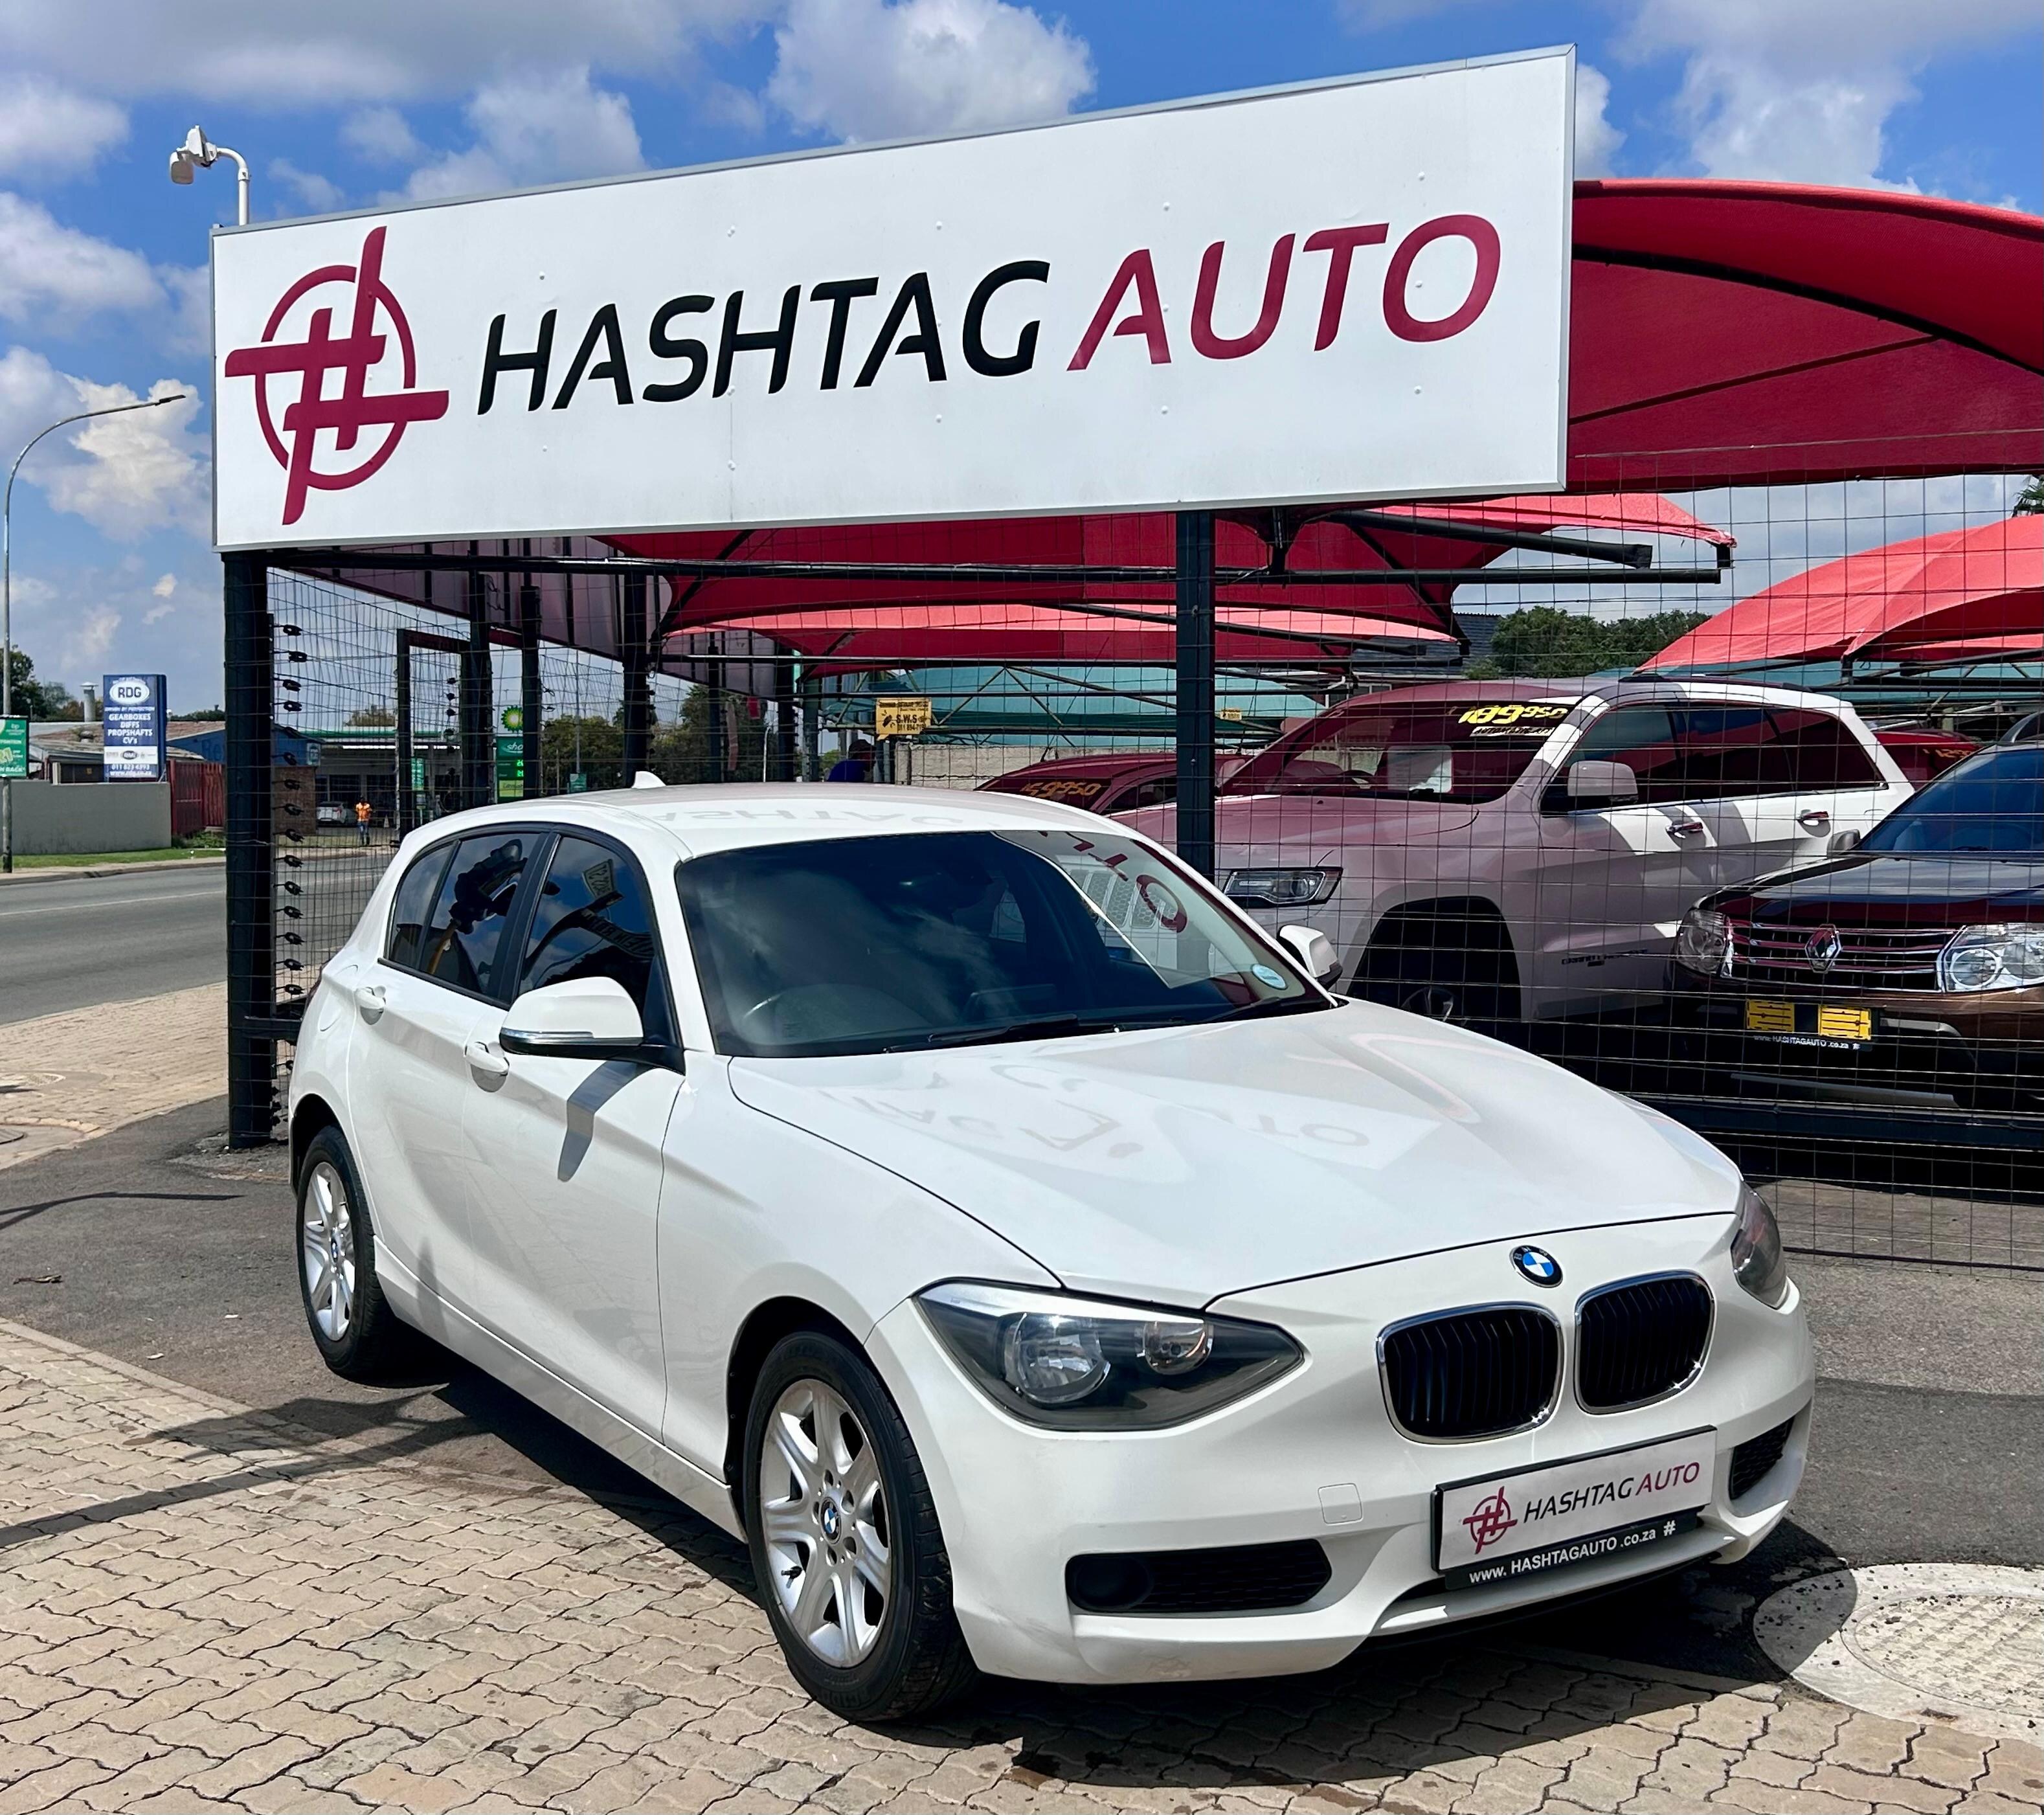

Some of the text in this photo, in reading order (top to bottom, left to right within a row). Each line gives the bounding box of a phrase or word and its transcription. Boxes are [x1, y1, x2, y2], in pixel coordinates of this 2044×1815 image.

[478, 215, 1501, 415] HASHTAG AUTO
[109, 713, 152, 721] GEARBOXES
[118, 686, 142, 698] RDG
[1523, 1462, 1700, 1523] HASHTAG AUTO
[1469, 1564, 1507, 1584] www.
[1511, 1537, 1617, 1574] HASHTAGAUTO
[1619, 1528, 1656, 1548] .co.za
